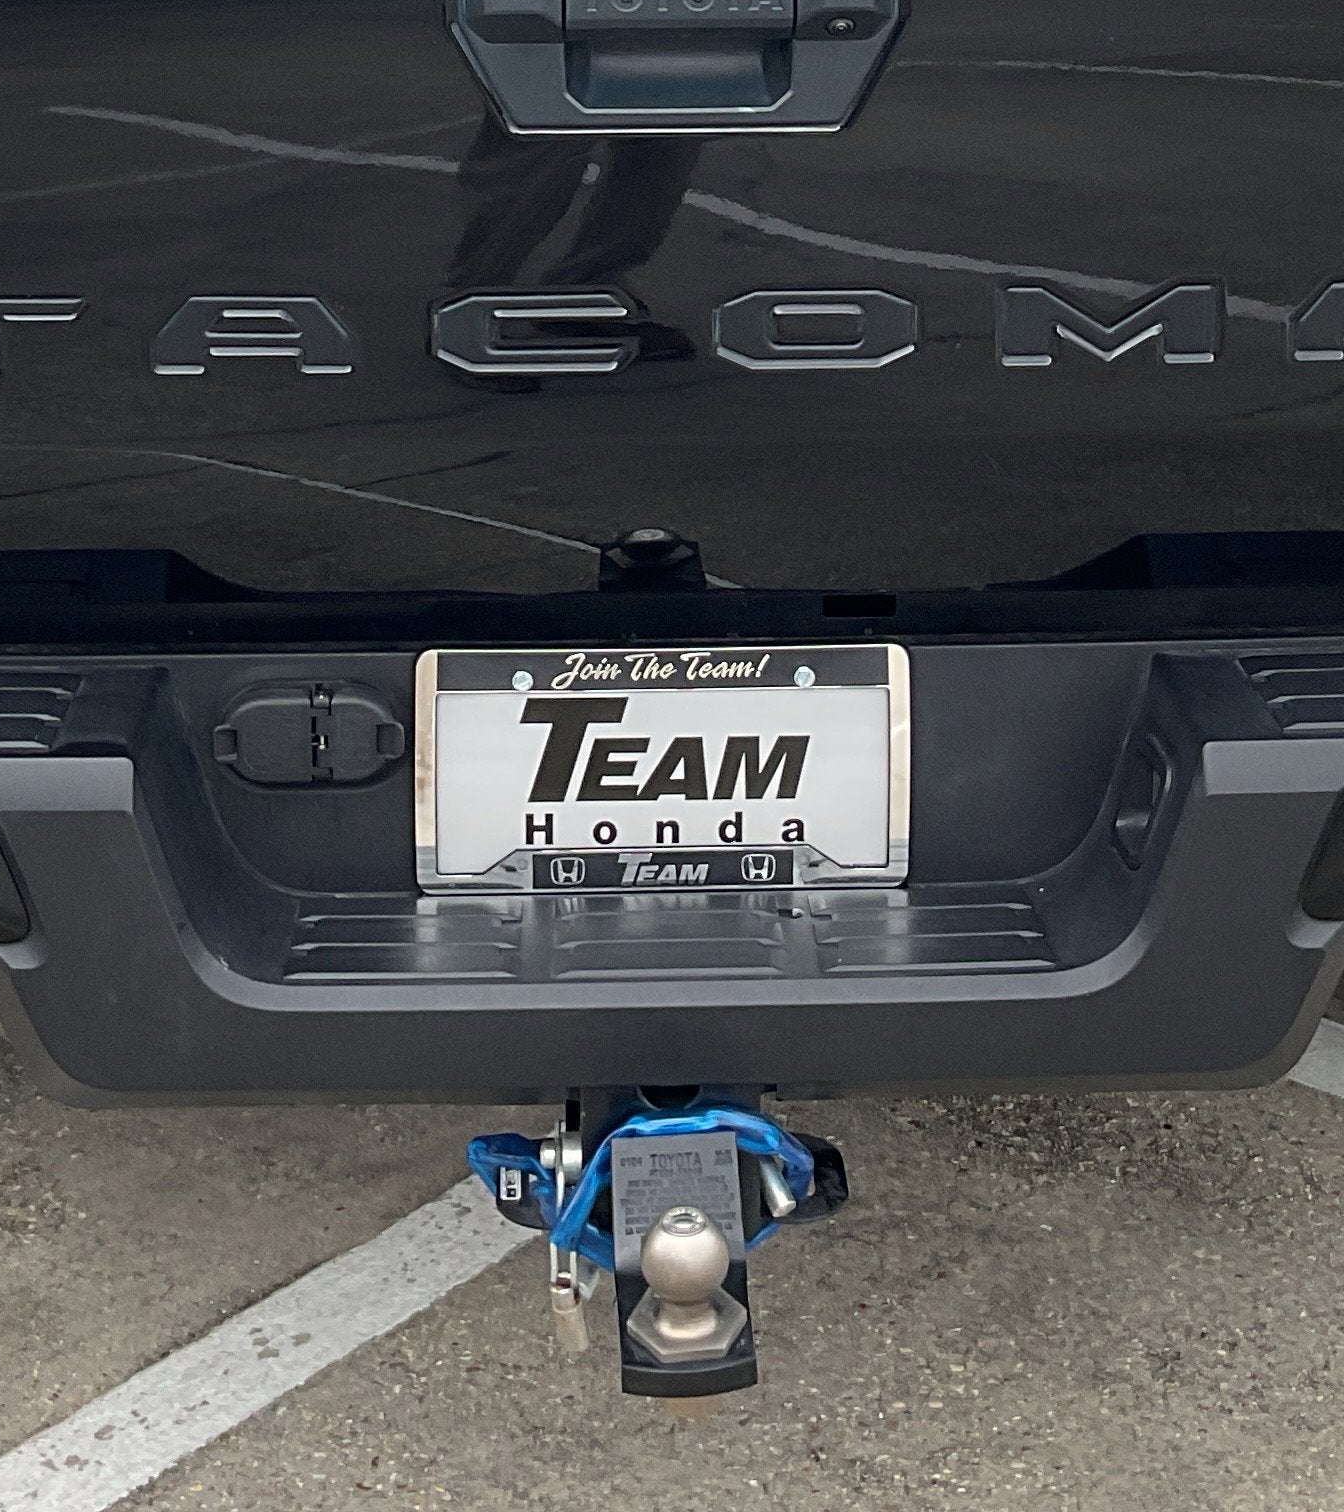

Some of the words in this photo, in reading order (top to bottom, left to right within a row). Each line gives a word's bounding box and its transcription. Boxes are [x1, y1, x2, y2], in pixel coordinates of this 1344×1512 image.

[551, 652, 622, 689] Join
[624, 652, 678, 681] The
[680, 652, 770, 681] Team!
[519, 696, 810, 803] TEAM
[525, 811, 805, 846] Honda
[617, 852, 709, 886] TEAM
[649, 1151, 703, 1168] TOYOTA
